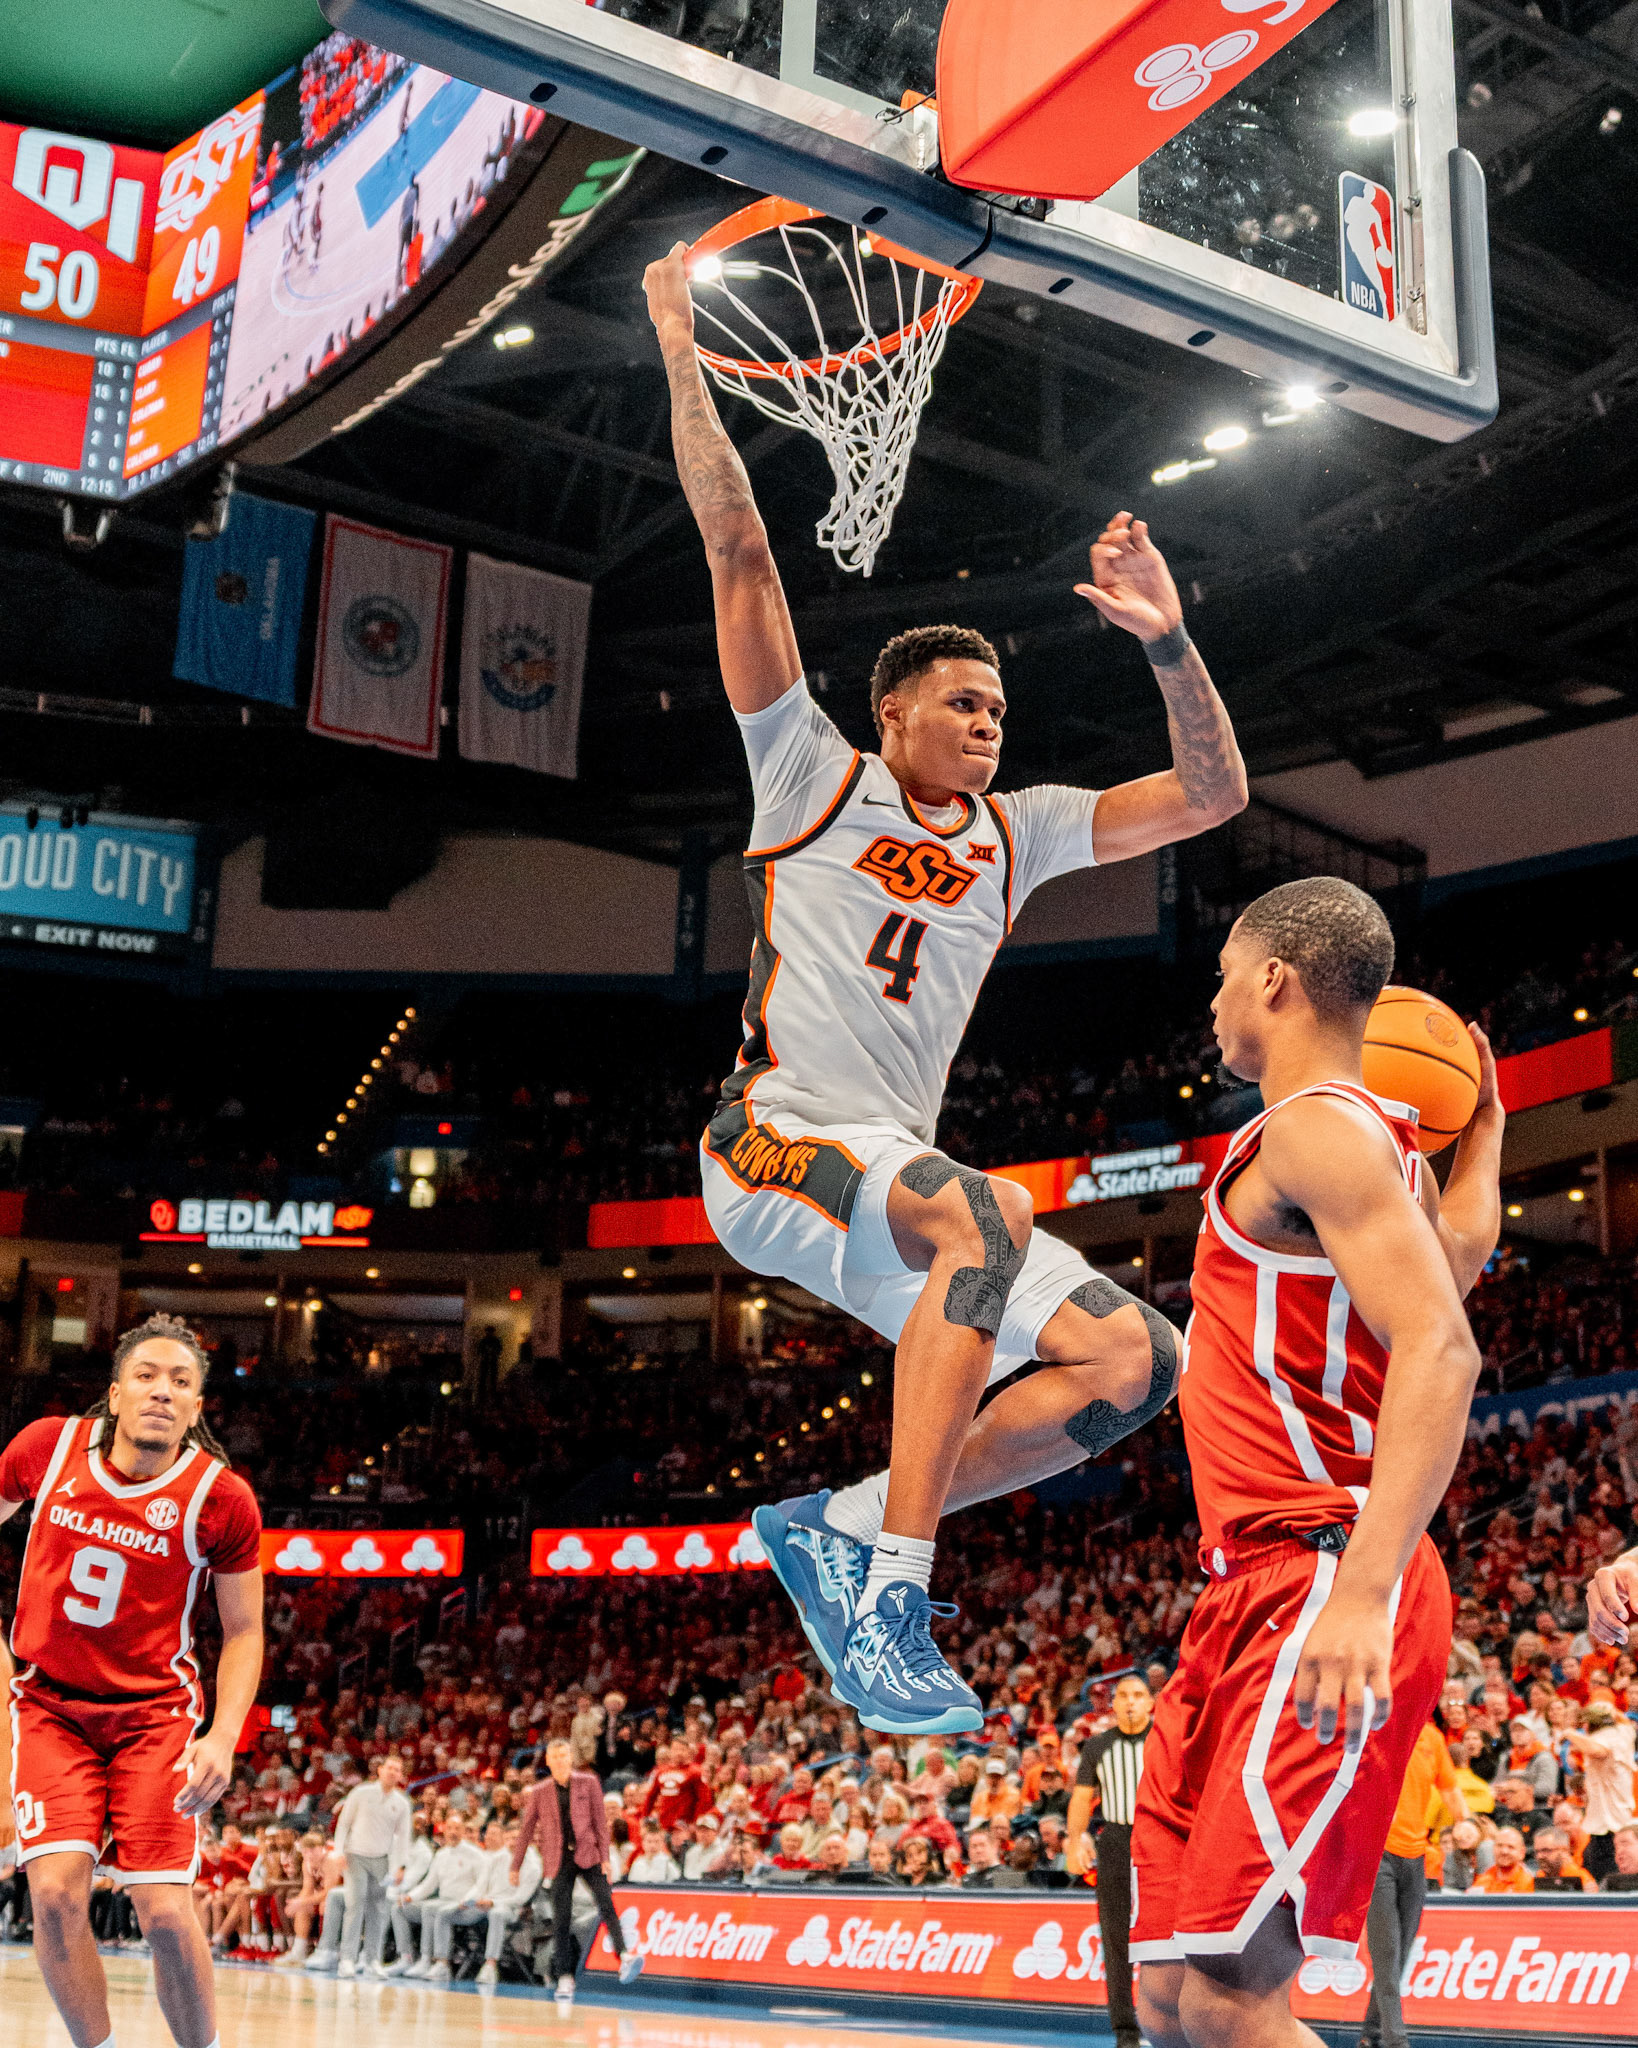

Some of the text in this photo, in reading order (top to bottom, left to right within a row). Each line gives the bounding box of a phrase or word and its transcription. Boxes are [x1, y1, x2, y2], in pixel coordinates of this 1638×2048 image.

[20, 242, 99, 319] 50
[172, 226, 221, 305] 49
[1351, 280, 1377, 312] NBA
[95, 337, 120, 355] PTS
[120, 341, 138, 358] FL
[98, 360, 132, 380] 10 1
[120, 387, 130, 403] 1
[117, 410, 127, 426] 1
[91, 430, 123, 449] 2 1
[13, 463, 25, 480] 4
[42, 469, 71, 488] 2ND
[81, 476, 118, 495] 12:15
[969, 843, 995, 863] XII
[92, 838, 185, 916] CITY
[851, 835, 981, 908] OSU
[35, 924, 156, 953] EXIT NOW
[865, 910, 929, 1005] 4
[731, 1127, 818, 1185] COWBYS
[1098, 1164, 1200, 1198] StateFarm
[178, 1199, 334, 1236] BEDLAM
[207, 1232, 301, 1250] BASKETBALL
[49, 1504, 169, 1558] OKLAHOMA
[148, 1499, 177, 1528] SEC
[1320, 1533, 1335, 1548] 44
[63, 1545, 128, 1629] 9
[15, 1791, 47, 1840] OU
[638, 1908, 772, 1963] StateFarm
[829, 1917, 994, 1975] StateFarm
[1399, 1935, 1630, 2005] tateFarm
